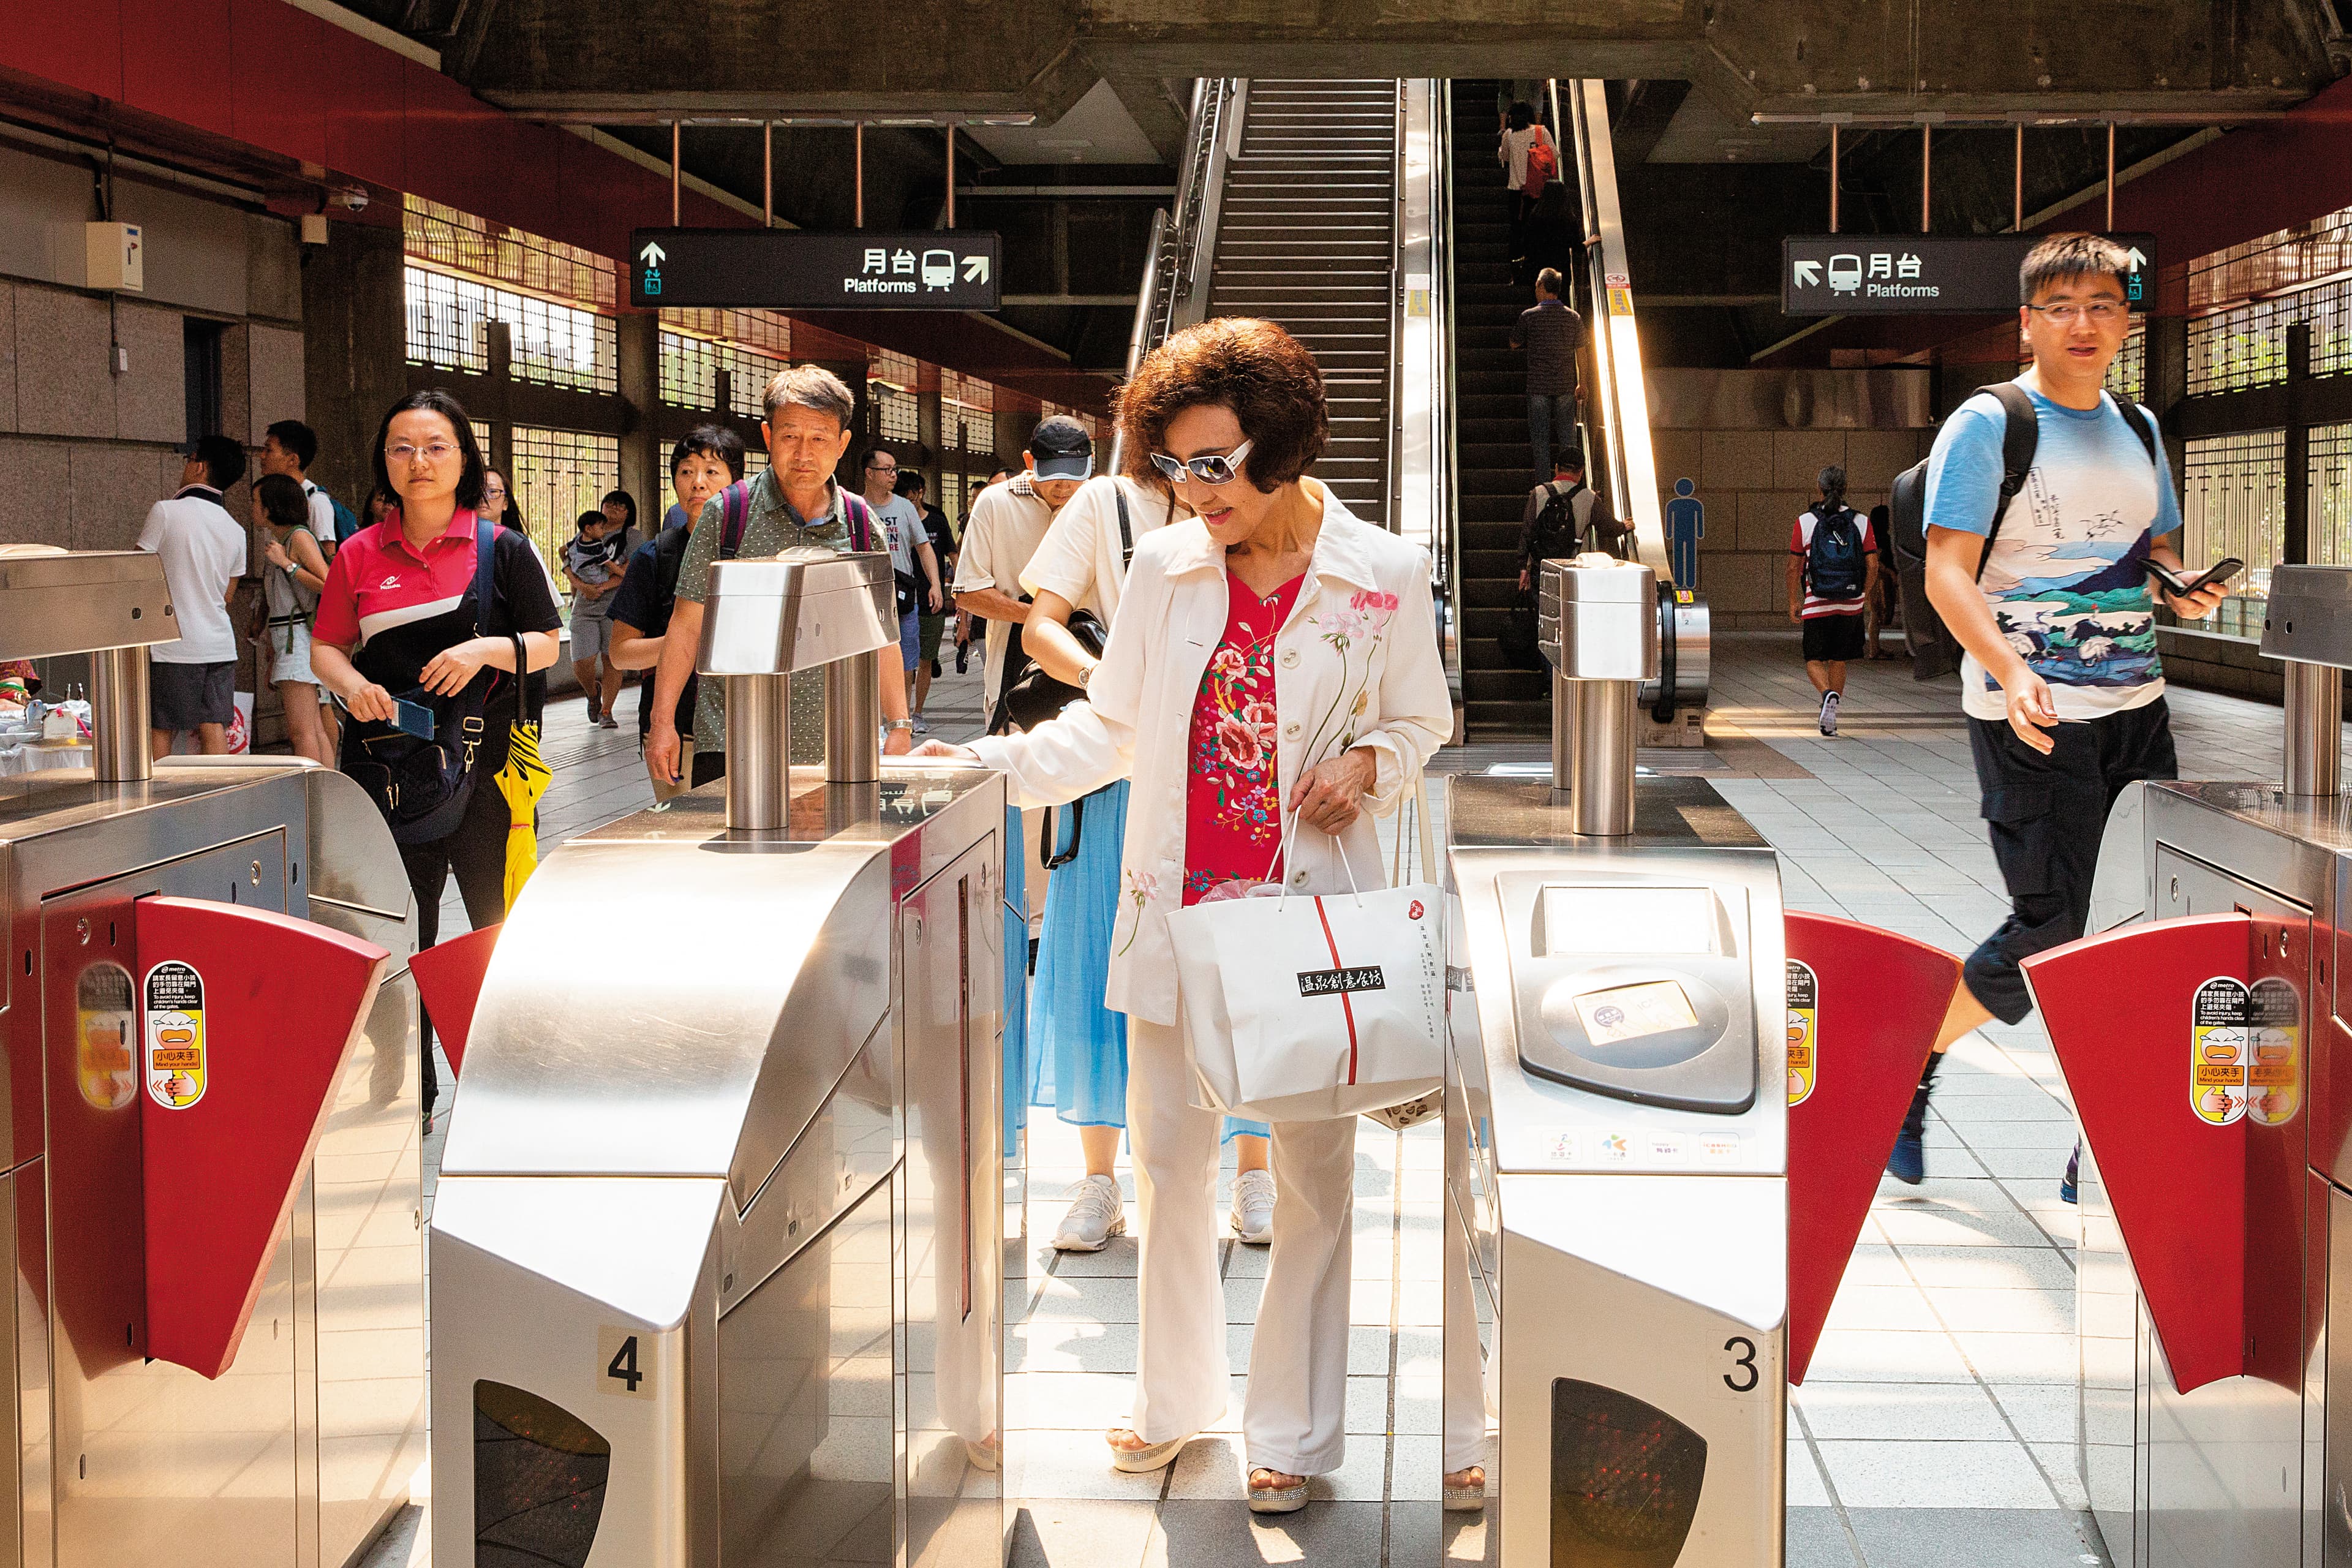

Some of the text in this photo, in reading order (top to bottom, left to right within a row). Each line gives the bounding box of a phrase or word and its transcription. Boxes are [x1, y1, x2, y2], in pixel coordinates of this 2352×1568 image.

[862, 249, 916, 274] 月台
[1868, 253, 1922, 279] 月台
[845, 279, 916, 293] Platforms
[1867, 284, 1940, 297] Platforms
[157, 1051, 195, 1061] 小心夾手
[2201, 1068, 2239, 1077] 小心夾手
[608, 1336, 643, 1392] 4
[1723, 1336, 1759, 1392] 3
